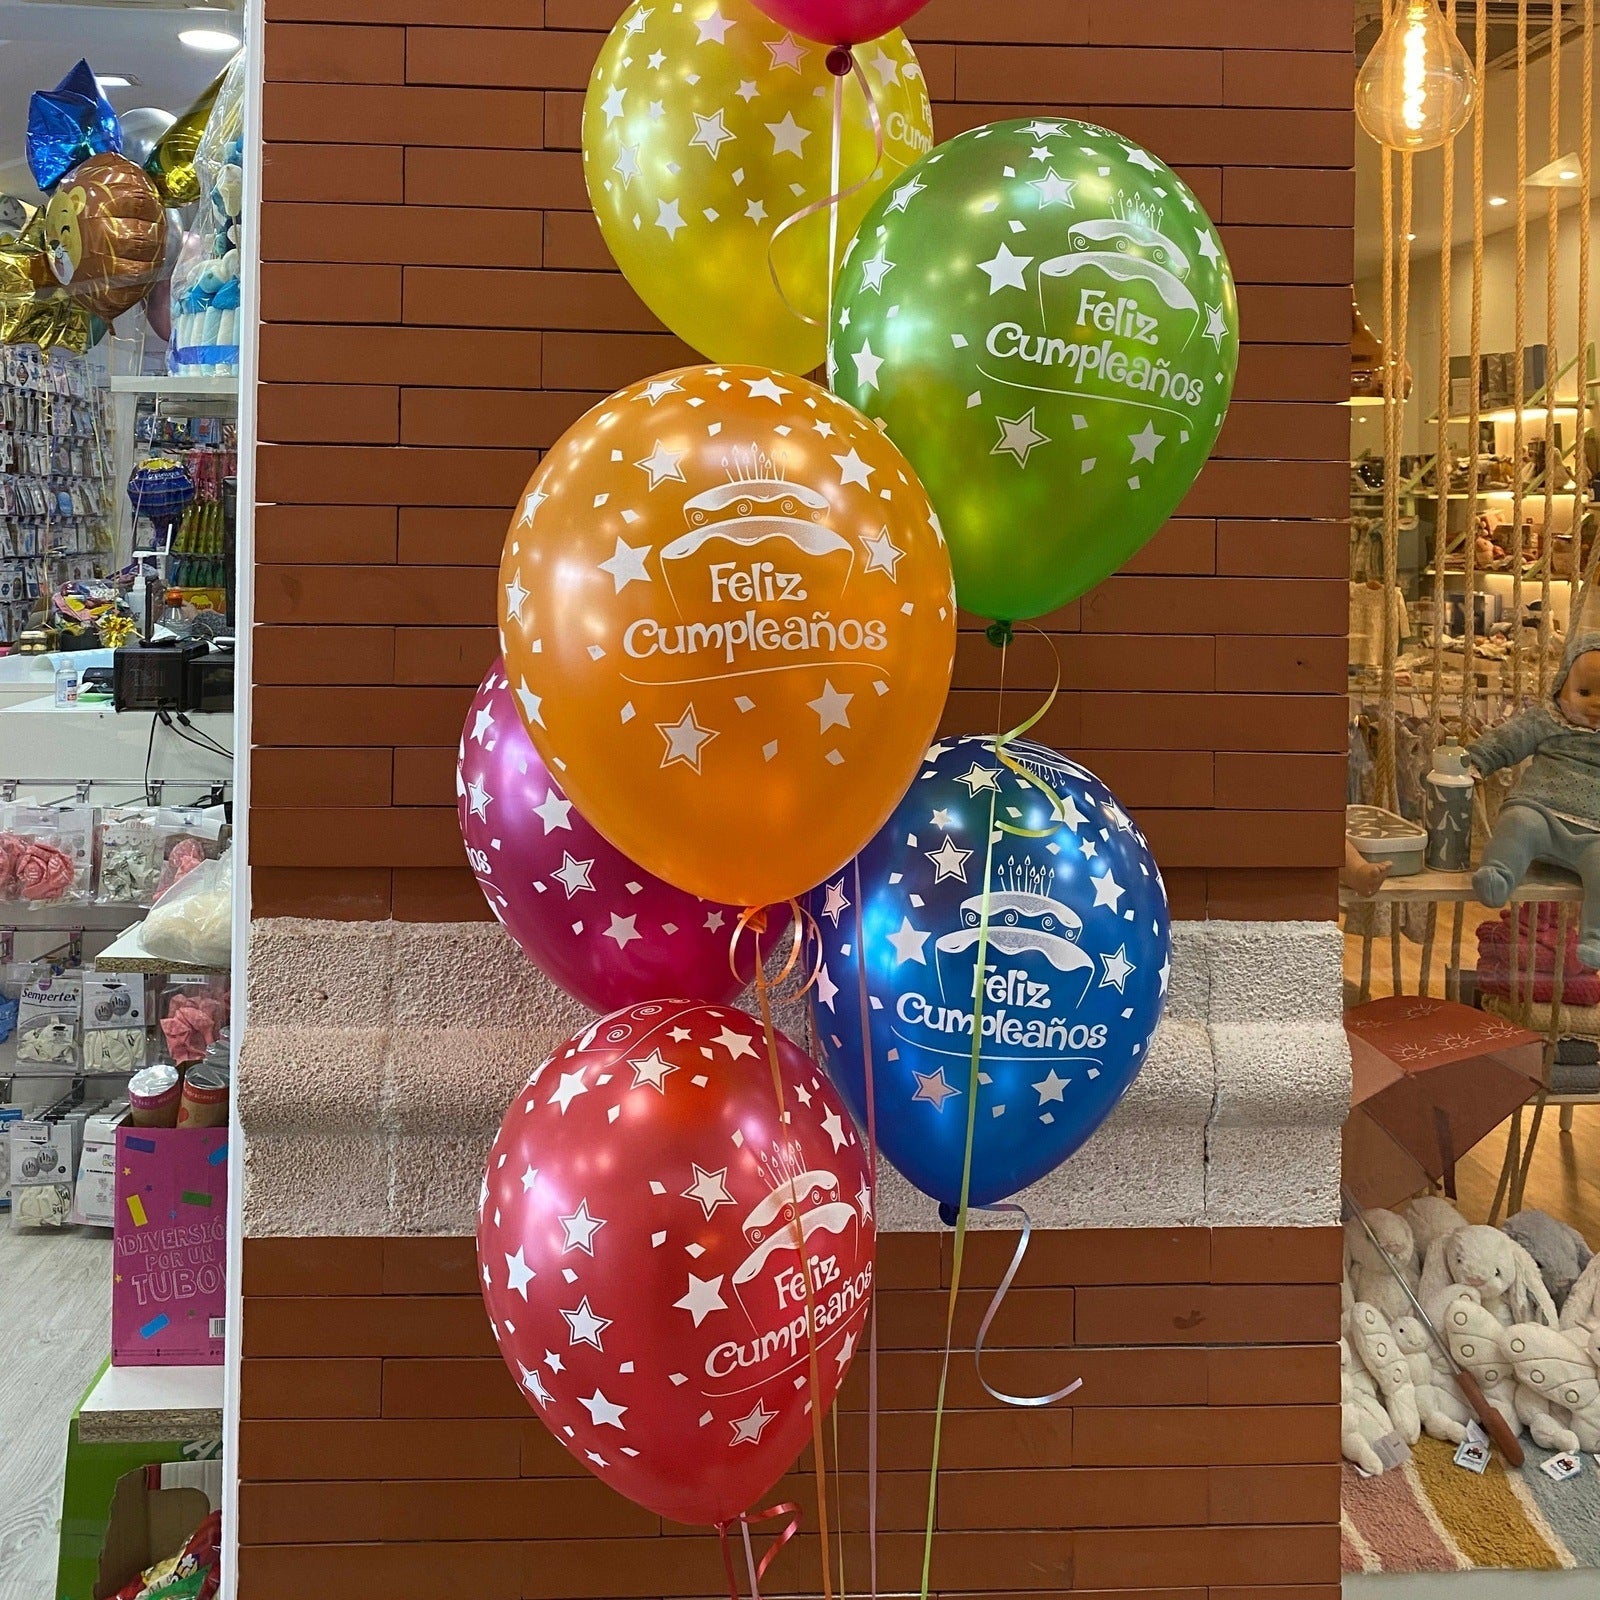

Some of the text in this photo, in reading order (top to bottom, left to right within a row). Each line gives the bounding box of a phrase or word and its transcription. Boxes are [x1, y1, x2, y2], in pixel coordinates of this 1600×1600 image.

[1076, 288, 1159, 345] Feliz
[985, 322, 1204, 407] Cumpleaños
[709, 561, 808, 603] Feliz
[622, 609, 888, 664] Cumpleaños
[22, 987, 77, 1003] Sempertex
[970, 963, 1051, 1009] Feliz
[896, 991, 1108, 1051] Cumpleaños
[117, 1215, 225, 1258] ¡DIVERSIÓ
[145, 1244, 216, 1272] POR UN
[704, 1260, 872, 1378] Cumpleaños
